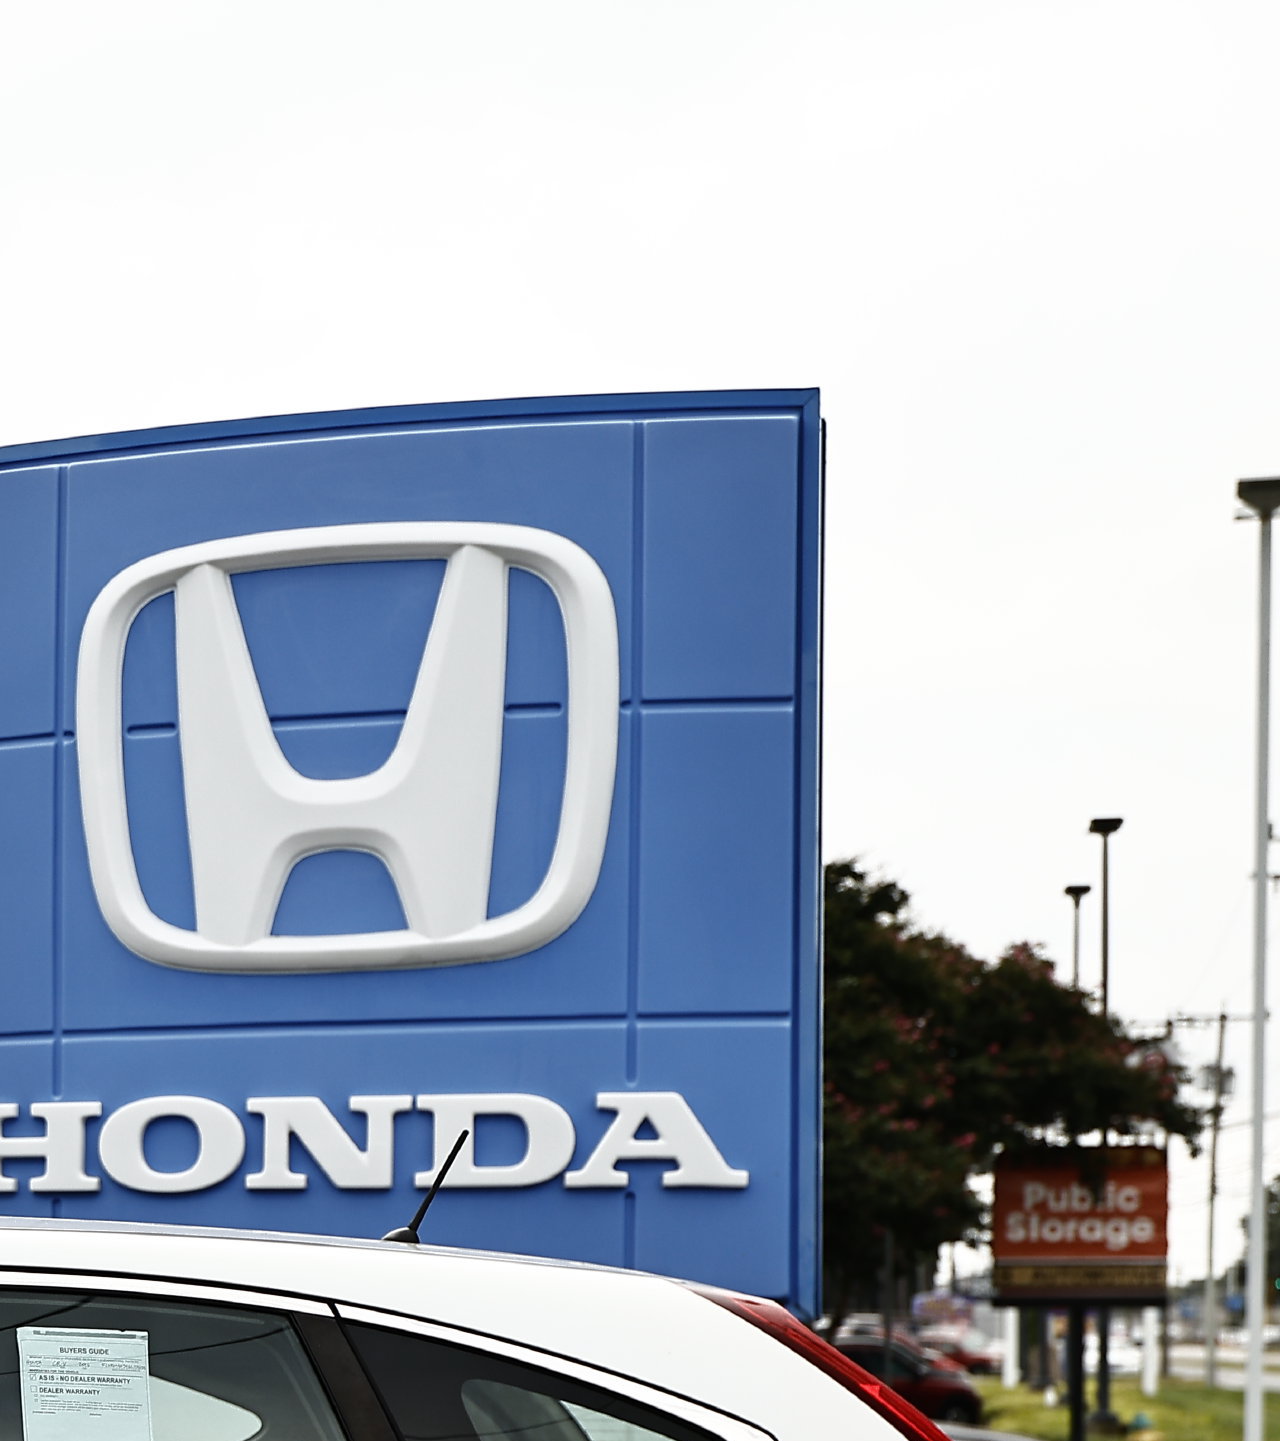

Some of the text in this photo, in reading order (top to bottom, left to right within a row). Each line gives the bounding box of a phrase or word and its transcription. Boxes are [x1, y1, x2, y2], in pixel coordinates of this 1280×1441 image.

[1023, 1181, 1141, 1213] Pubic
[1004, 1211, 1155, 1251] Storage
[65, 1388, 100, 1396] WARRANTY
